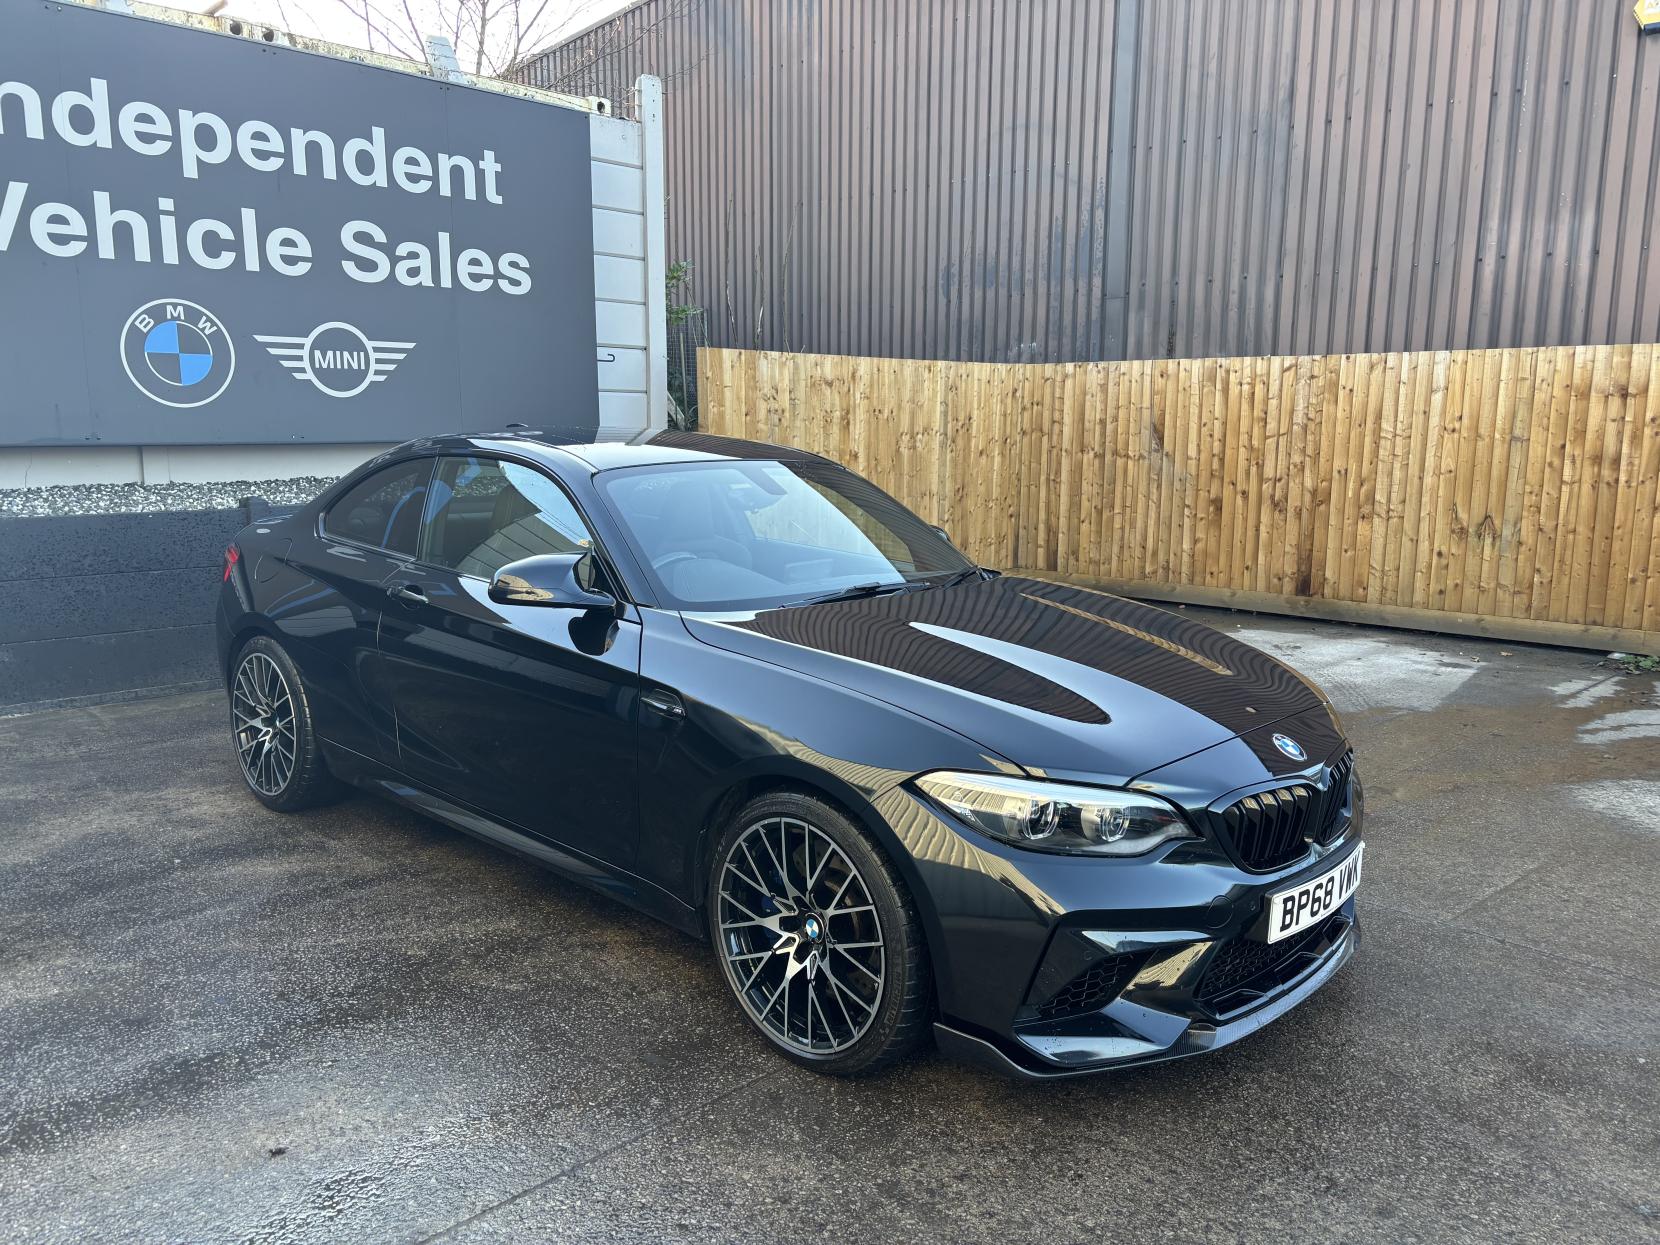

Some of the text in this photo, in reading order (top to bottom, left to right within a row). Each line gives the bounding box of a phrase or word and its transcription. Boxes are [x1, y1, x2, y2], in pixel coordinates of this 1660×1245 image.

[340, 220, 534, 296] Sales
[134, 304, 218, 336] BMW
[314, 349, 366, 370] MINI
[1280, 875, 1335, 933] BP68
